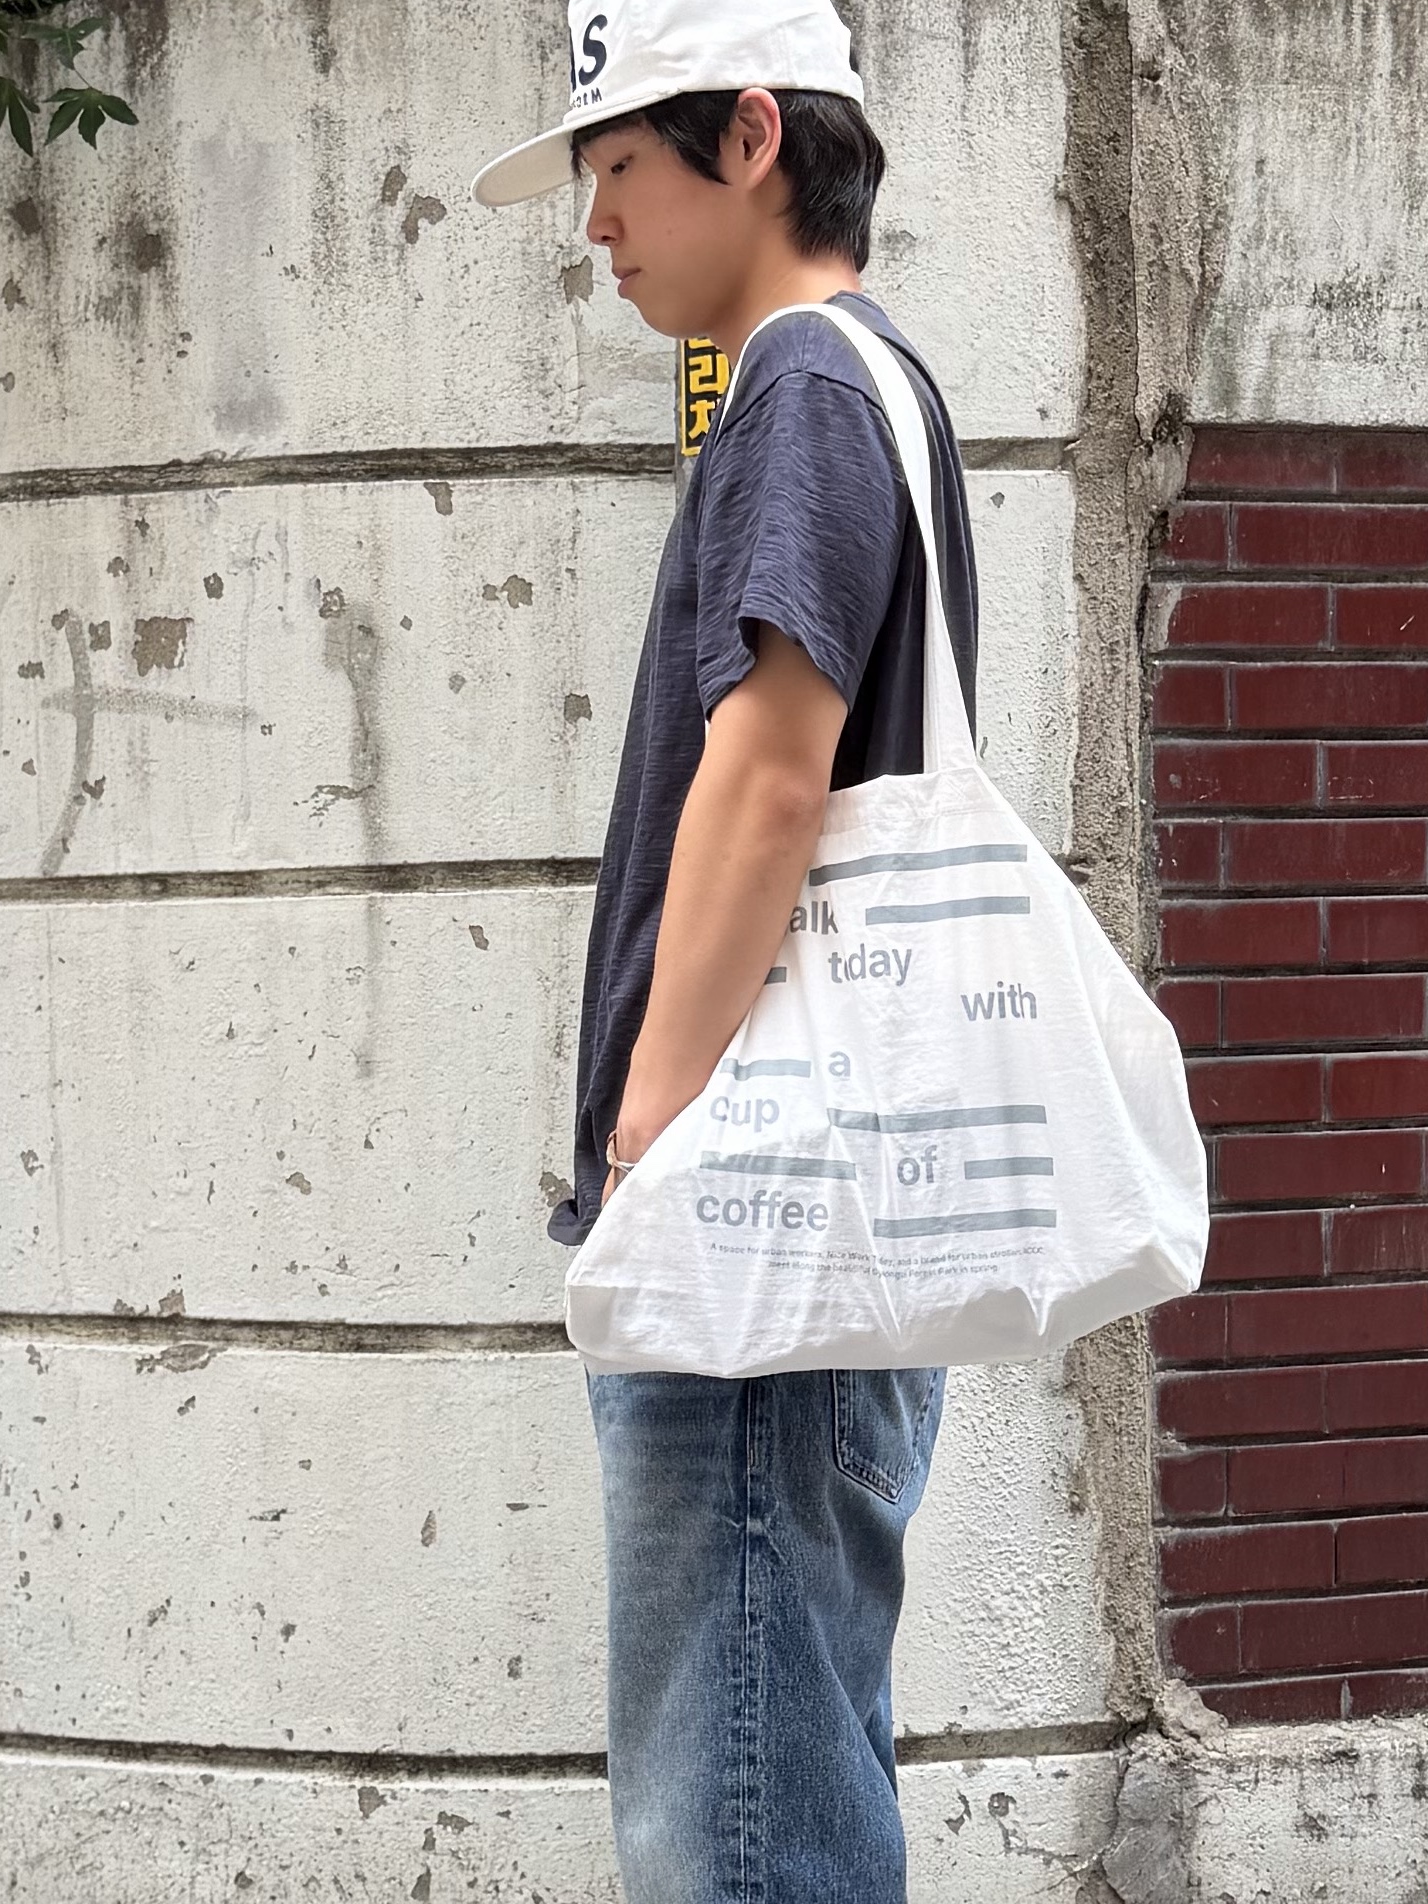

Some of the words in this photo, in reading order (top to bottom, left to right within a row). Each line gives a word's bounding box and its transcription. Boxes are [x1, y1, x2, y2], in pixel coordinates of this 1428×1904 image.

[569, 14, 608, 93] S
[688, 339, 730, 440] 리차
[789, 900, 839, 935] alk
[827, 943, 913, 986] tday
[960, 981, 1037, 1021] with
[827, 1050, 852, 1078] a
[709, 1094, 781, 1134] cup
[896, 1144, 938, 1186] of
[695, 1189, 829, 1232] coffee
